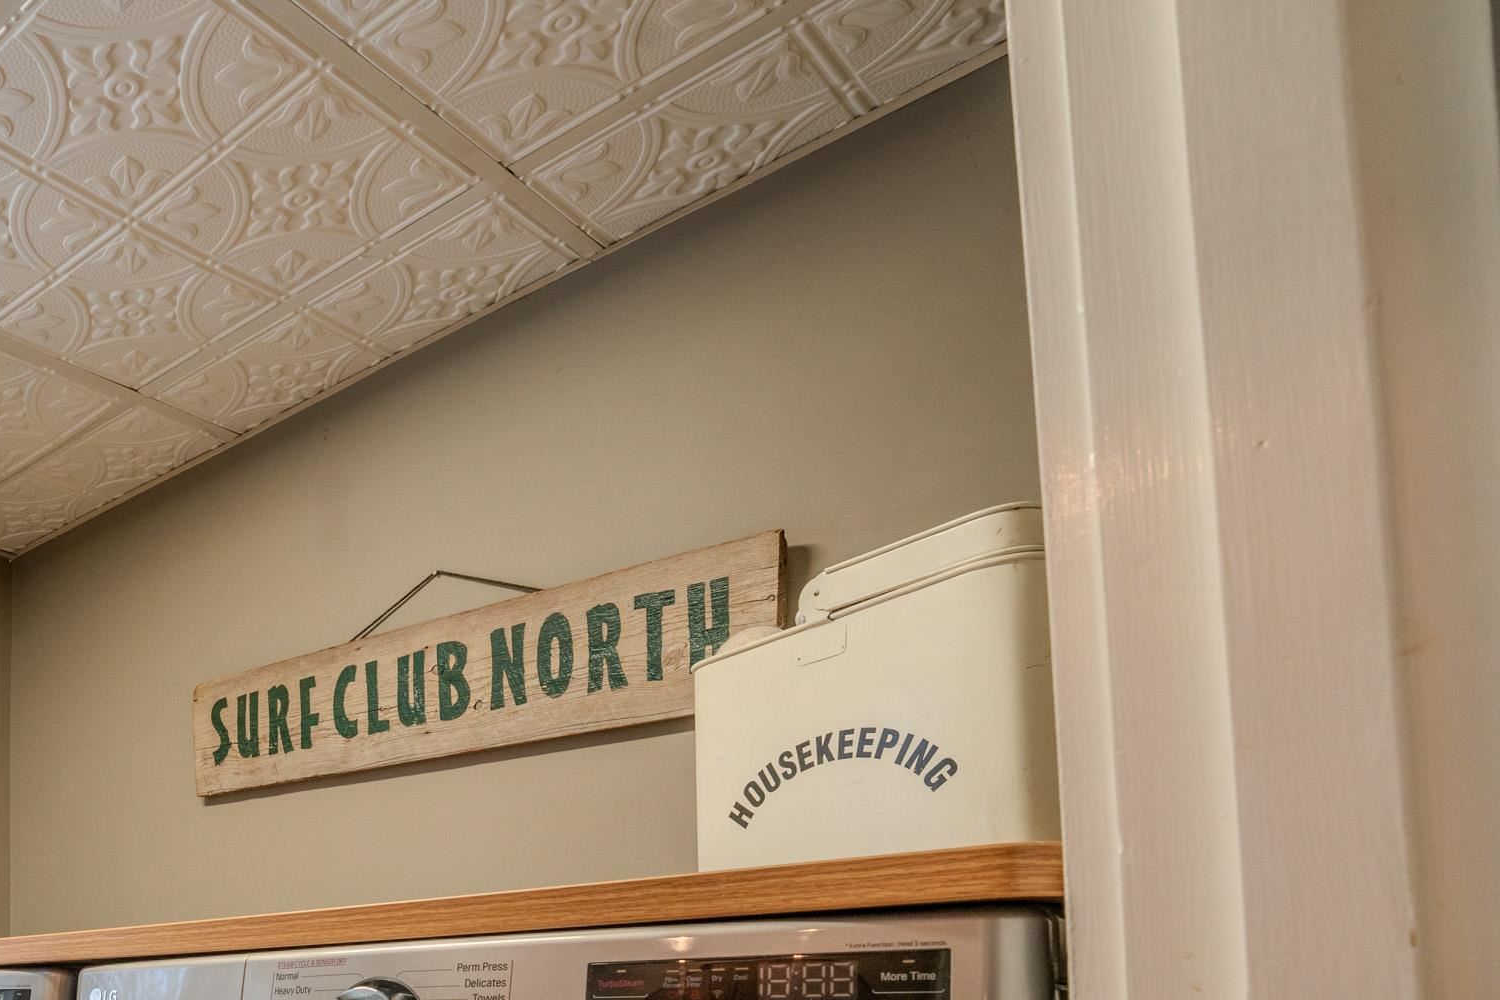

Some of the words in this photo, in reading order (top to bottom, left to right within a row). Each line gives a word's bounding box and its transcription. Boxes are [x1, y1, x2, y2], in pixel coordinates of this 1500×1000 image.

[210, 674, 321, 767] SURF
[332, 640, 469, 740] CLUB
[489, 576, 730, 711] NORTH
[728, 727, 958, 829] HOUSEKEEPING
[276, 972, 299, 981] Normal
[711, 975, 723, 983] Dry
[880, 972, 907, 981] More
[909, 971, 937, 981] Time
[464, 978, 507, 988] Delicates
[274, 987, 295, 996] Heavy
[295, 986, 312, 995] Duty
